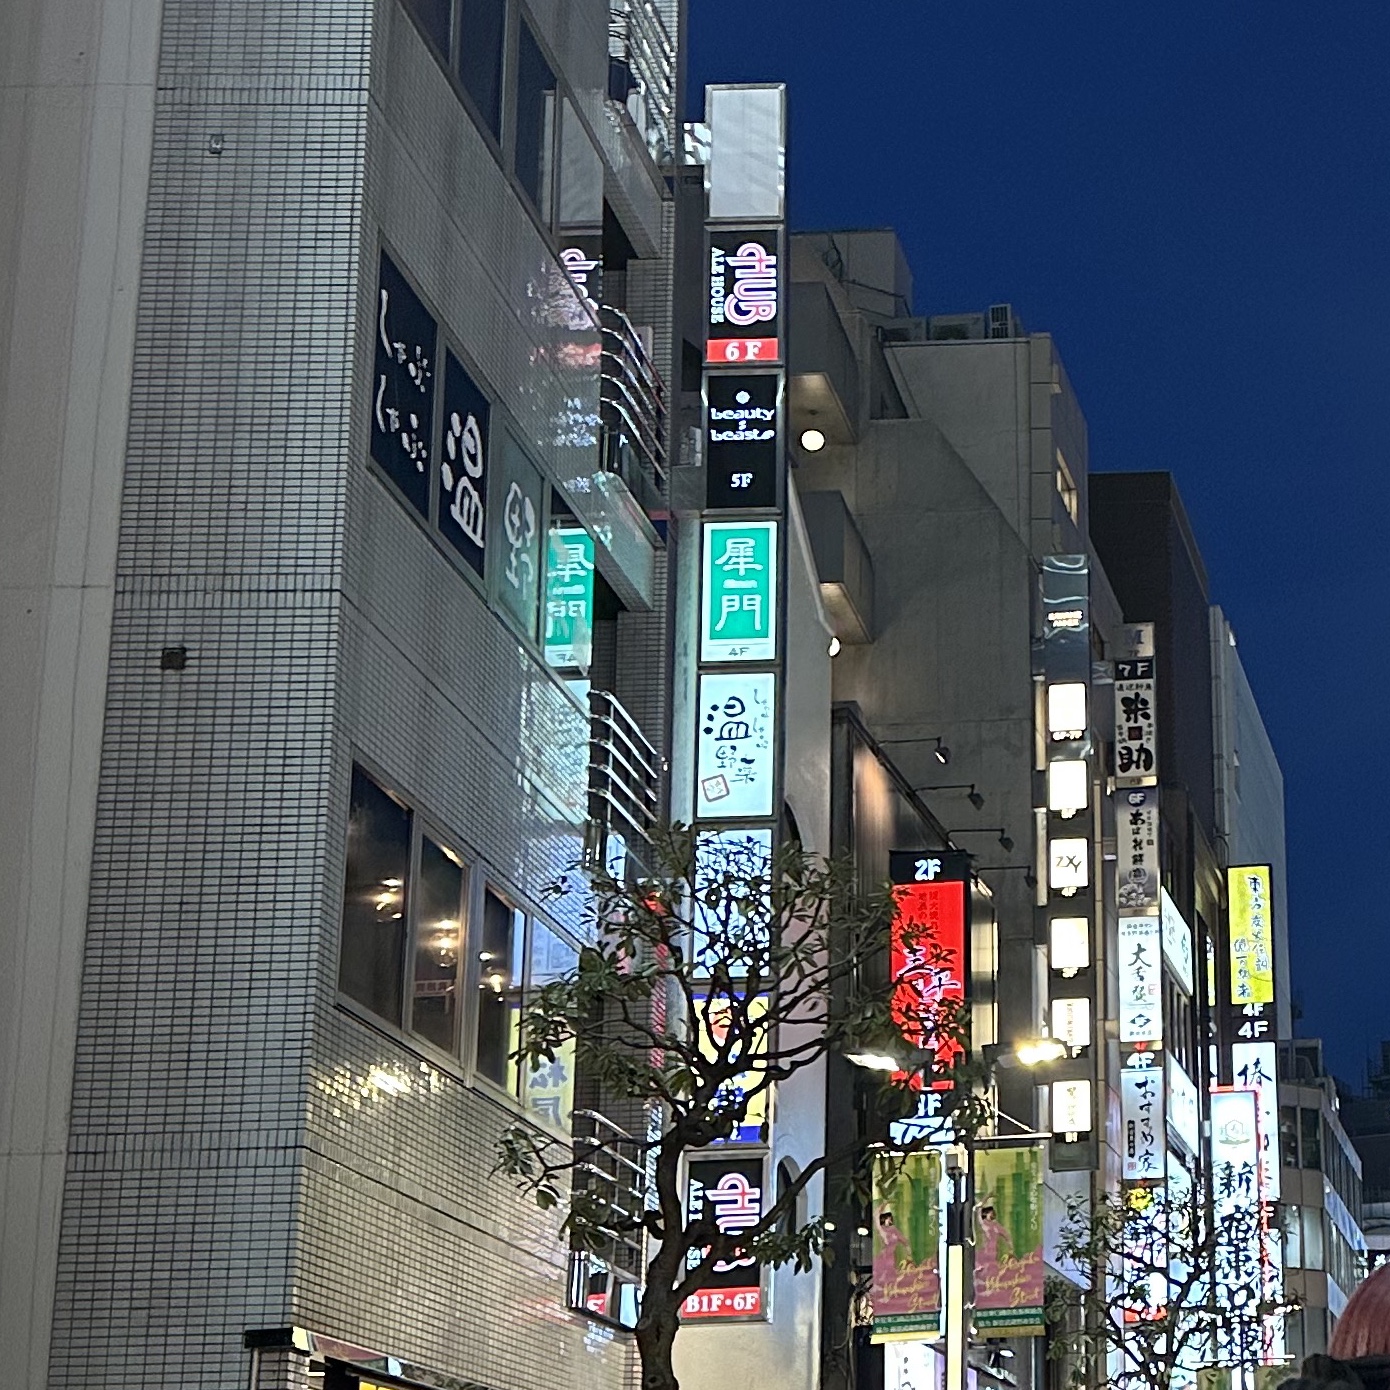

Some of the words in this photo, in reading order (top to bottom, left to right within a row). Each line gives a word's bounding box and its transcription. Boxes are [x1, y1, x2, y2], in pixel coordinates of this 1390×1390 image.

[711, 247, 725, 275] ALE
[711, 279, 725, 323] HOUSE
[730, 473, 754, 488] 5F
[728, 647, 750, 657] 4F
[915, 859, 941, 880] 2F
[1238, 1021, 1269, 1039] 4F
